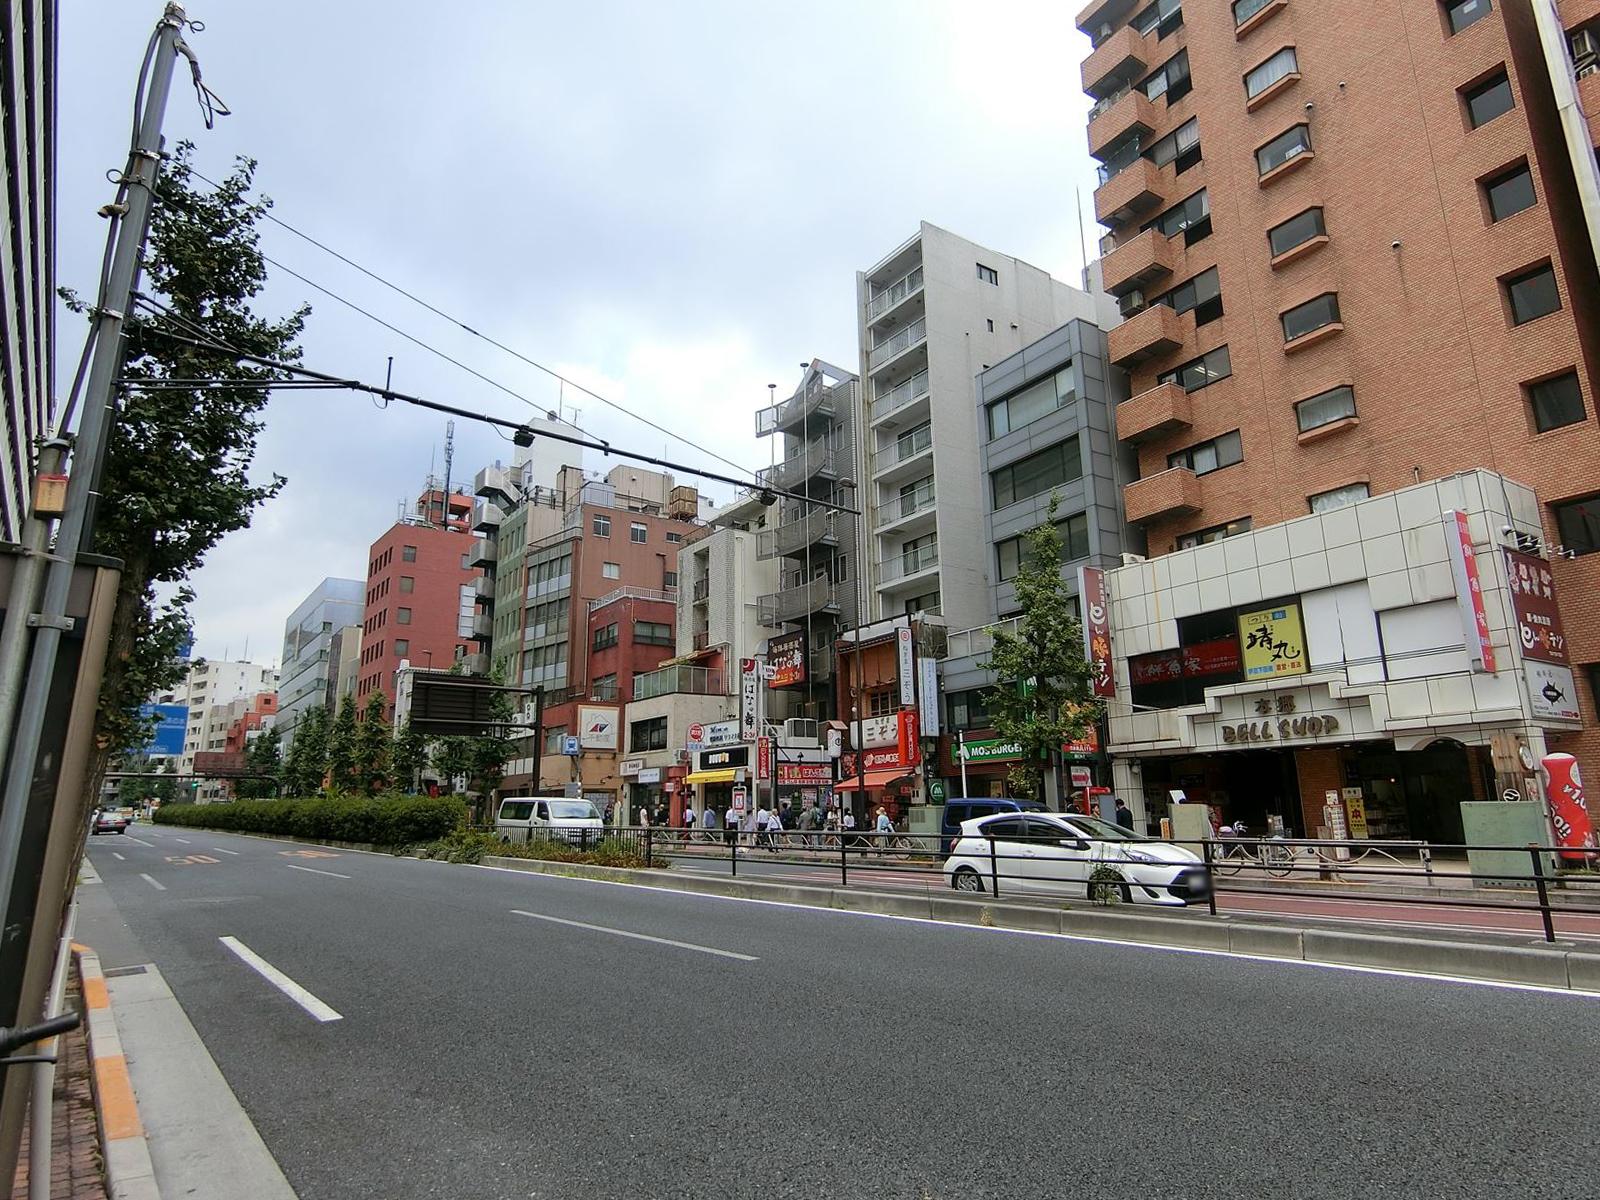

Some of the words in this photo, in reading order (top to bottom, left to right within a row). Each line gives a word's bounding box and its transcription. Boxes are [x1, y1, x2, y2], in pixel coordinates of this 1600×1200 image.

[1221, 721, 1273, 743] BELL
[1277, 714, 1339, 739] SHOP
[971, 746, 990, 757] MOS
[163, 854, 222, 866] 50
